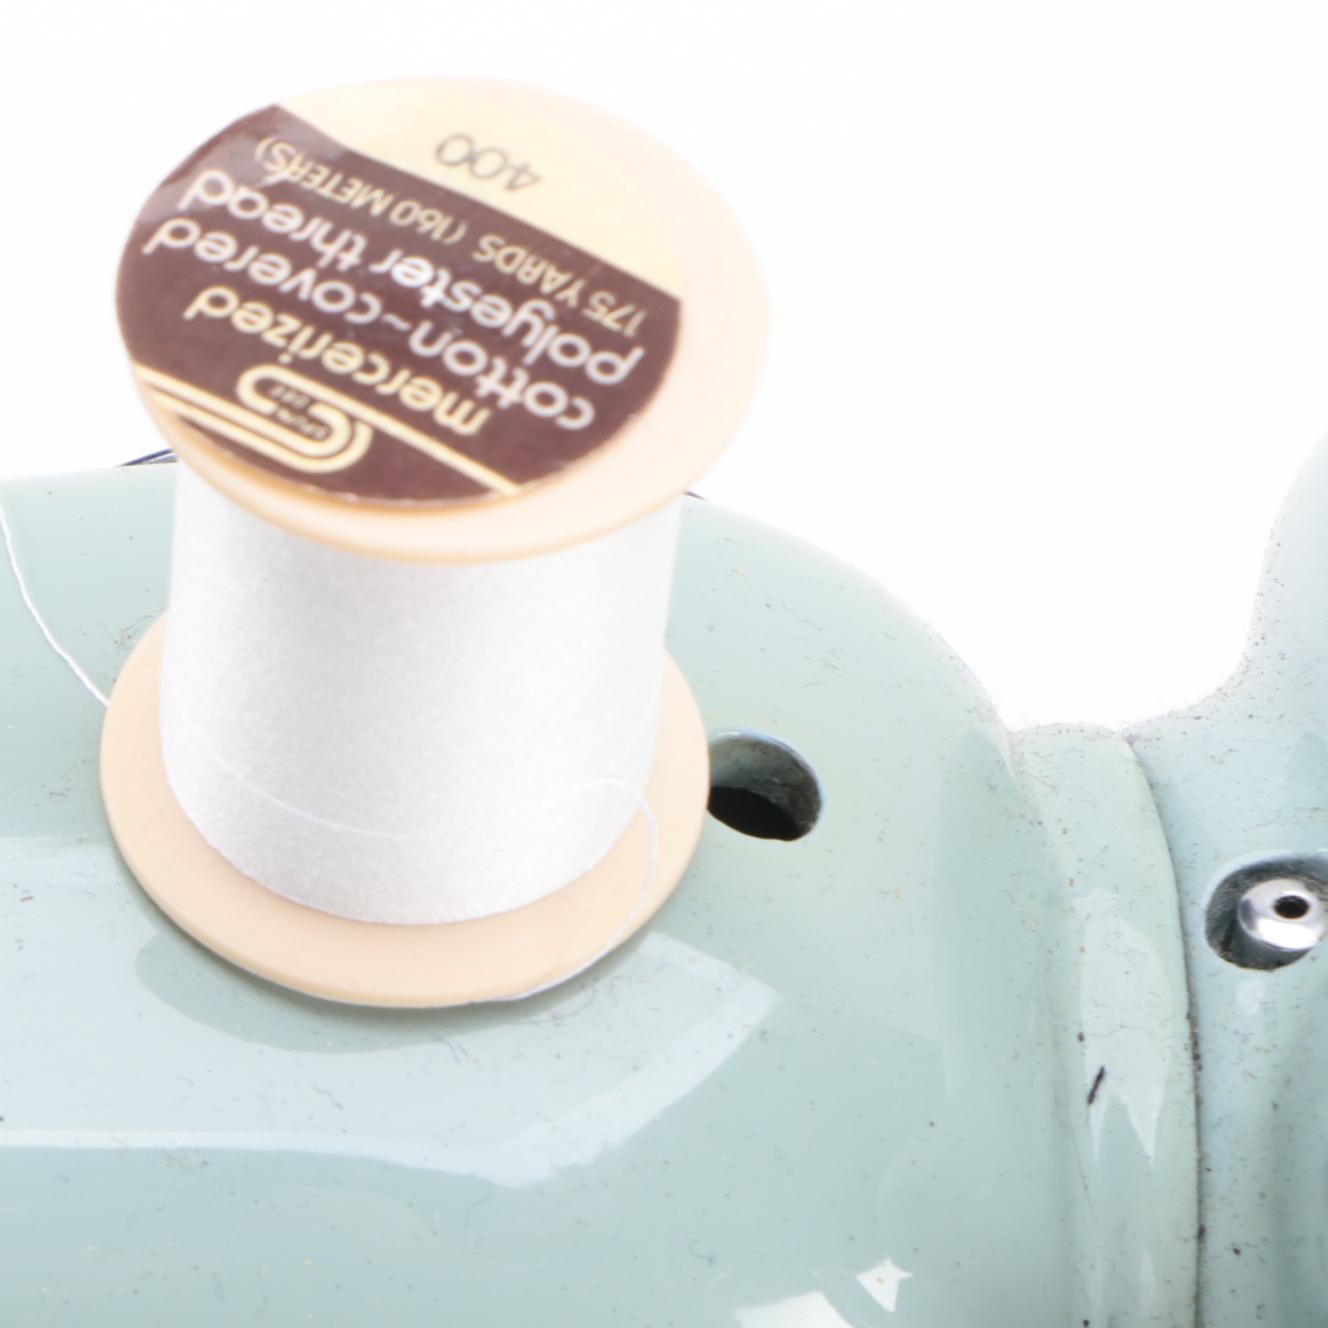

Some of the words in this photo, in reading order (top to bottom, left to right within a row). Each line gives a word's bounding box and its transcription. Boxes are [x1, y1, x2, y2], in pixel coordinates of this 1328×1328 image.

[255, 137, 394, 217] METERS)
[435, 133, 542, 192] 400
[178, 168, 366, 271] thread
[389, 200, 467, 245] (160
[472, 234, 586, 308] YARDS
[368, 250, 644, 384] polyester
[582, 291, 647, 338] 175
[183, 286, 491, 435] mercerized
